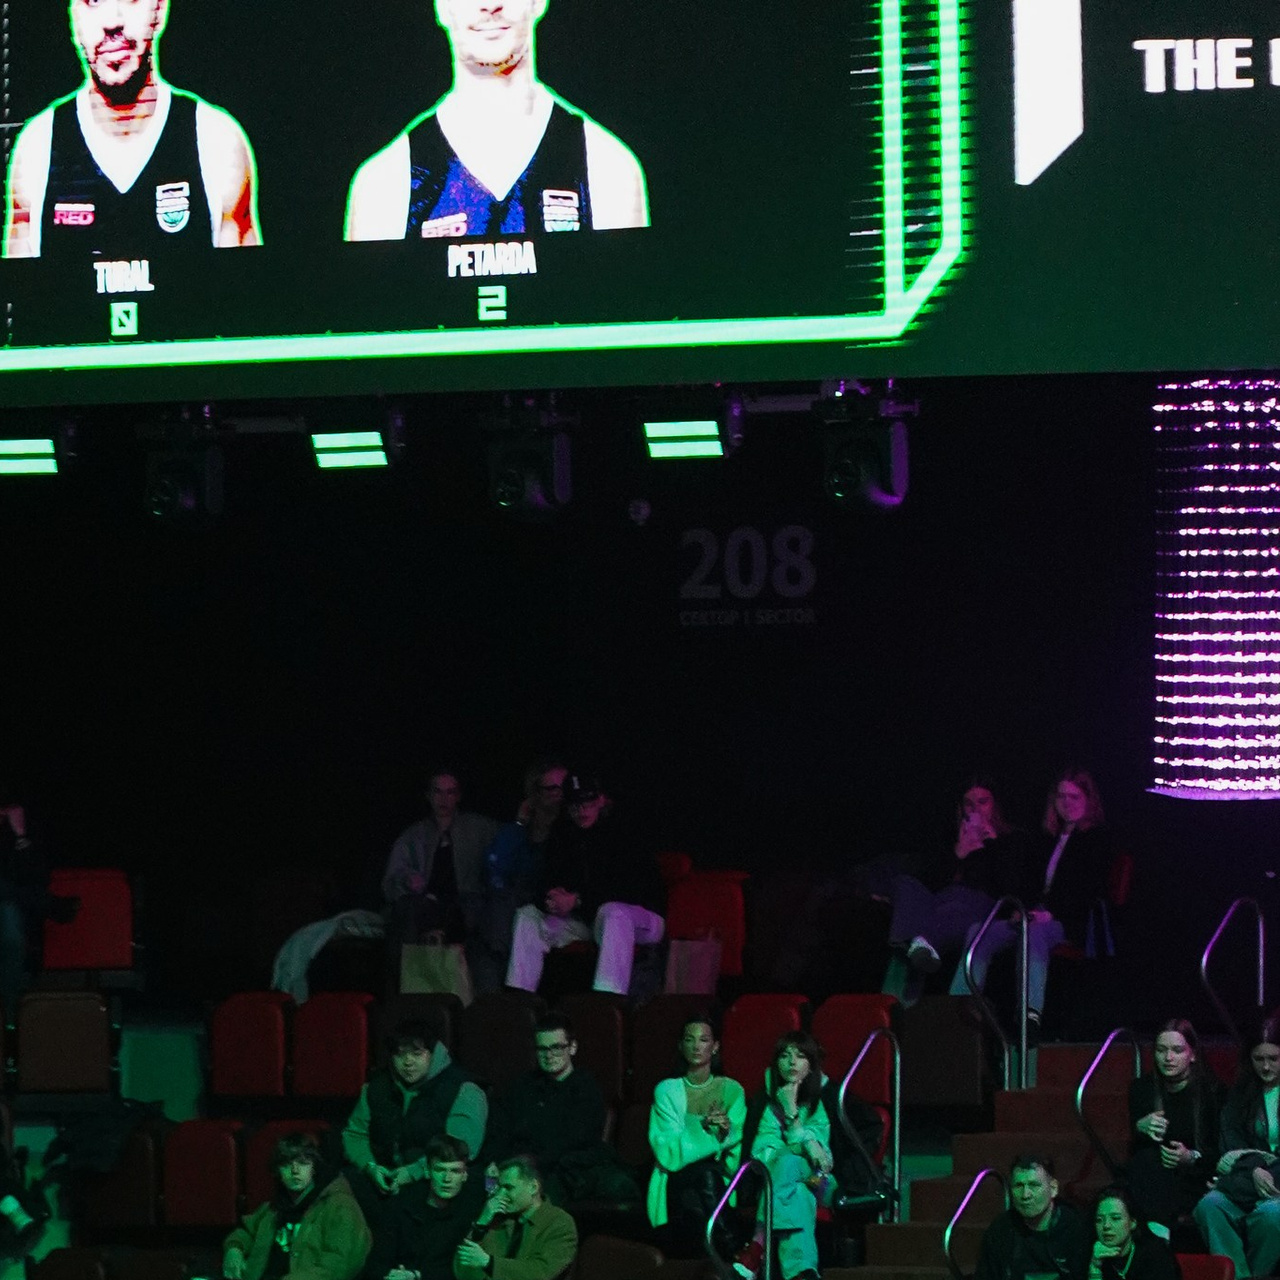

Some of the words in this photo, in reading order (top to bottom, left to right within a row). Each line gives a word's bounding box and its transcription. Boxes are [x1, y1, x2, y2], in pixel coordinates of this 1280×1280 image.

[1132, 38, 1254, 93] THE
[448, 241, 537, 278] PETARDA
[477, 285, 507, 321] 2
[679, 525, 818, 599] 208
